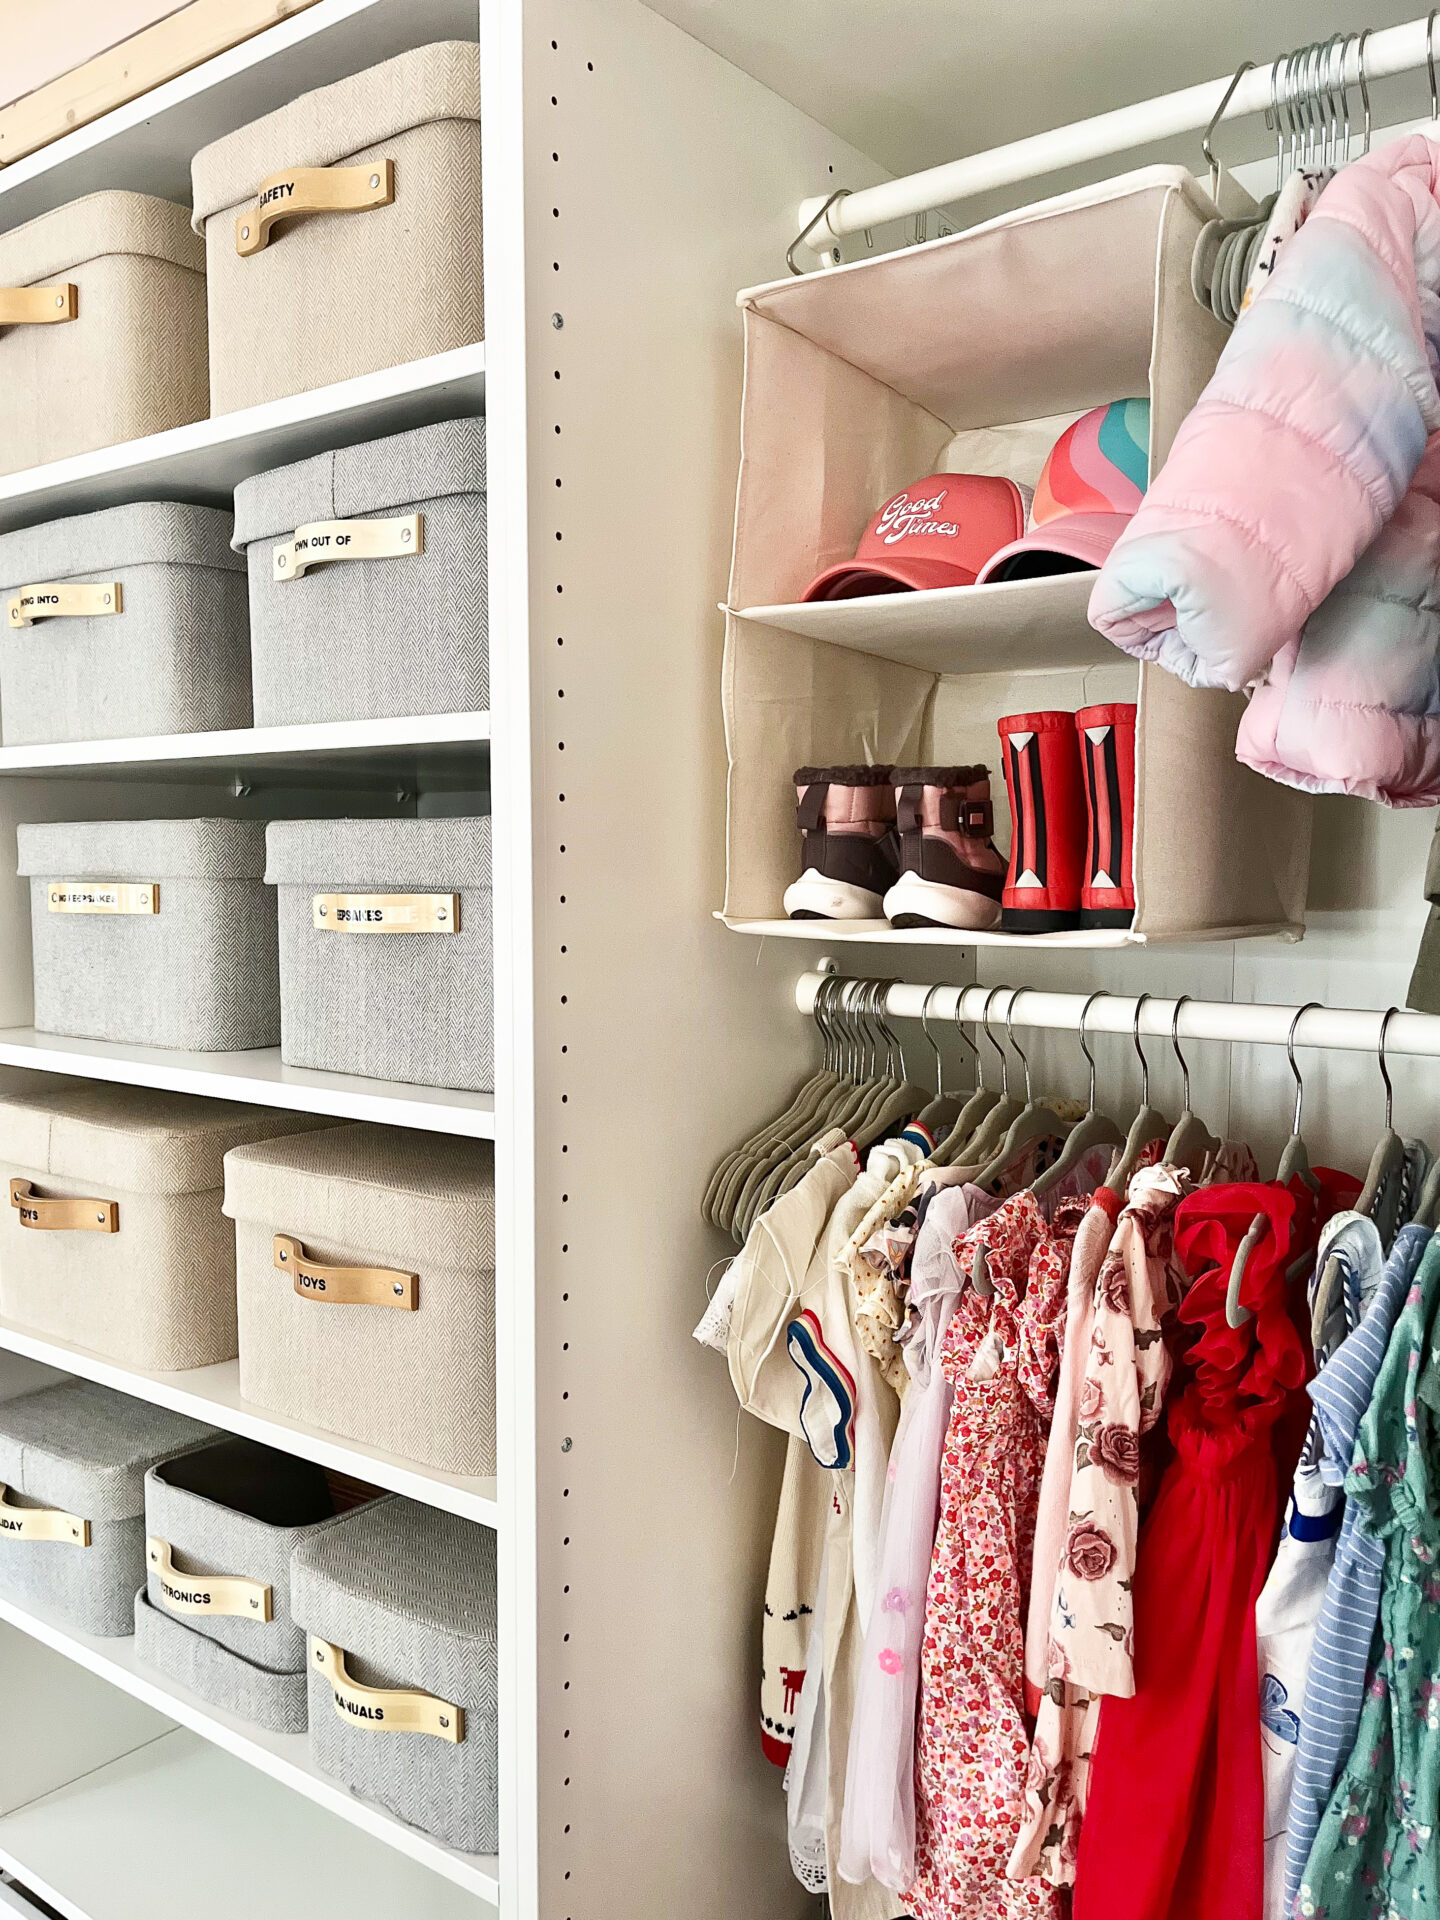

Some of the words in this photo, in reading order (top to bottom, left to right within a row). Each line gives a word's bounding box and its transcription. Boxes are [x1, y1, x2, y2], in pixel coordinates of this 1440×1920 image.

[259, 182, 295, 208] SAFETY
[875, 489, 949, 535] Good
[883, 510, 960, 544] Times
[311, 535, 331, 547] OUT
[336, 535, 352, 546] OF
[37, 594, 60, 605] INTO
[298, 1273, 327, 1291] TOYS
